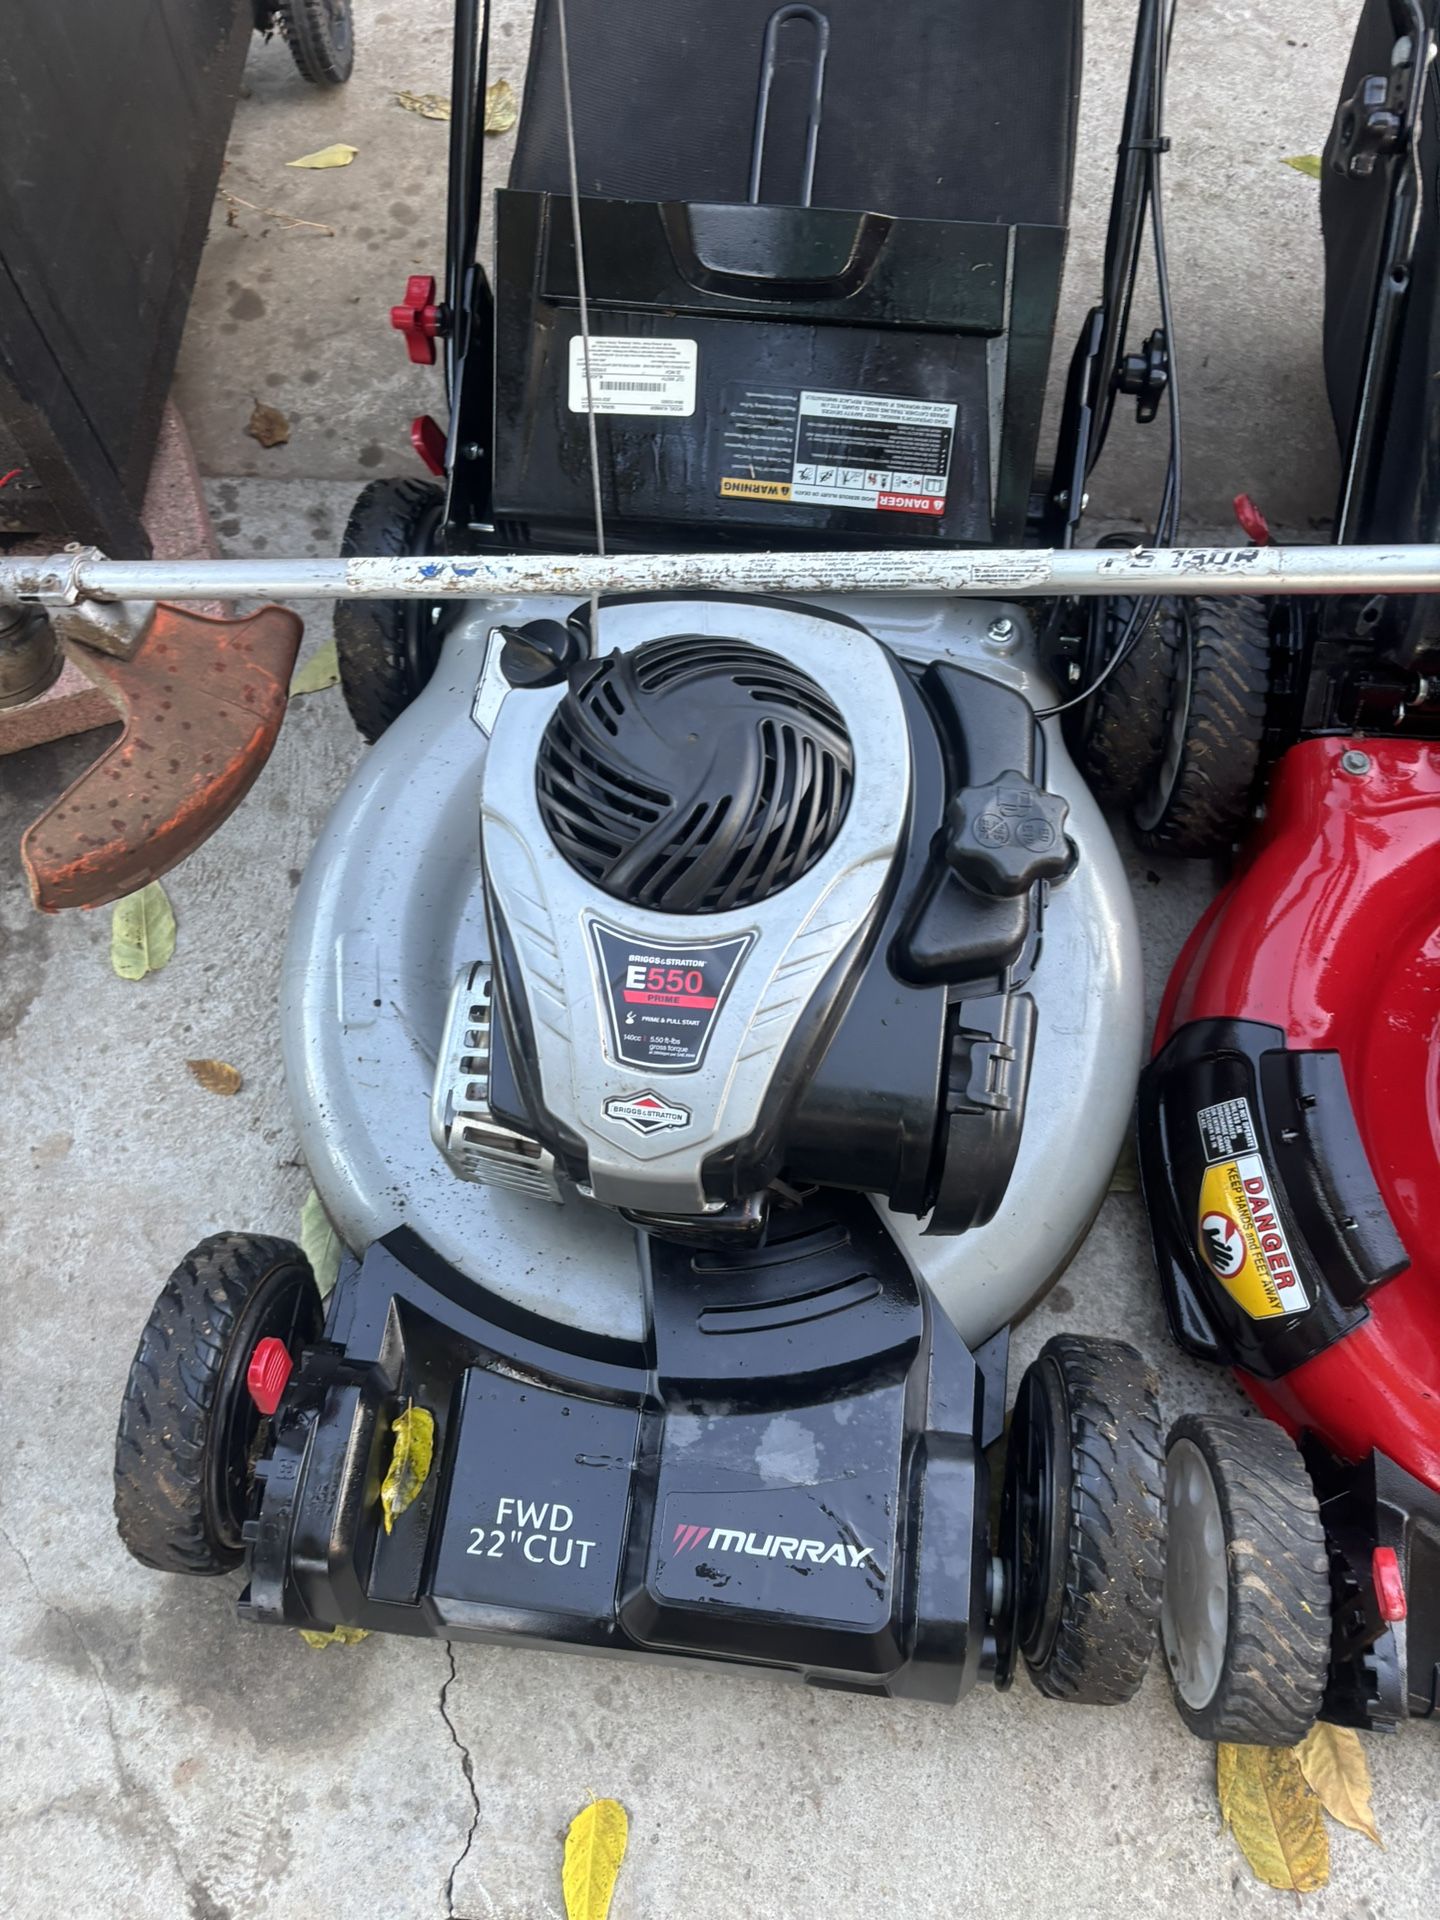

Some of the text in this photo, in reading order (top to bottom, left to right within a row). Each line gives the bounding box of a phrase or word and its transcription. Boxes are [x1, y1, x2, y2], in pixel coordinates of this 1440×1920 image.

[724, 482, 778, 495] WARNING
[880, 496, 929, 509] DANGER
[626, 965, 703, 994] E550
[647, 995, 680, 1004] PRIME
[649, 1044, 688, 1053] gross torque
[650, 1035, 664, 1043] 5.50
[1242, 1121, 1255, 1147] OPERATE
[1226, 1167, 1281, 1311] KEEP HANDS and FEET AWAY
[1243, 1176, 1298, 1290] DANGER
[496, 1498, 574, 1532] FWD
[708, 1528, 875, 1568] MURRAY
